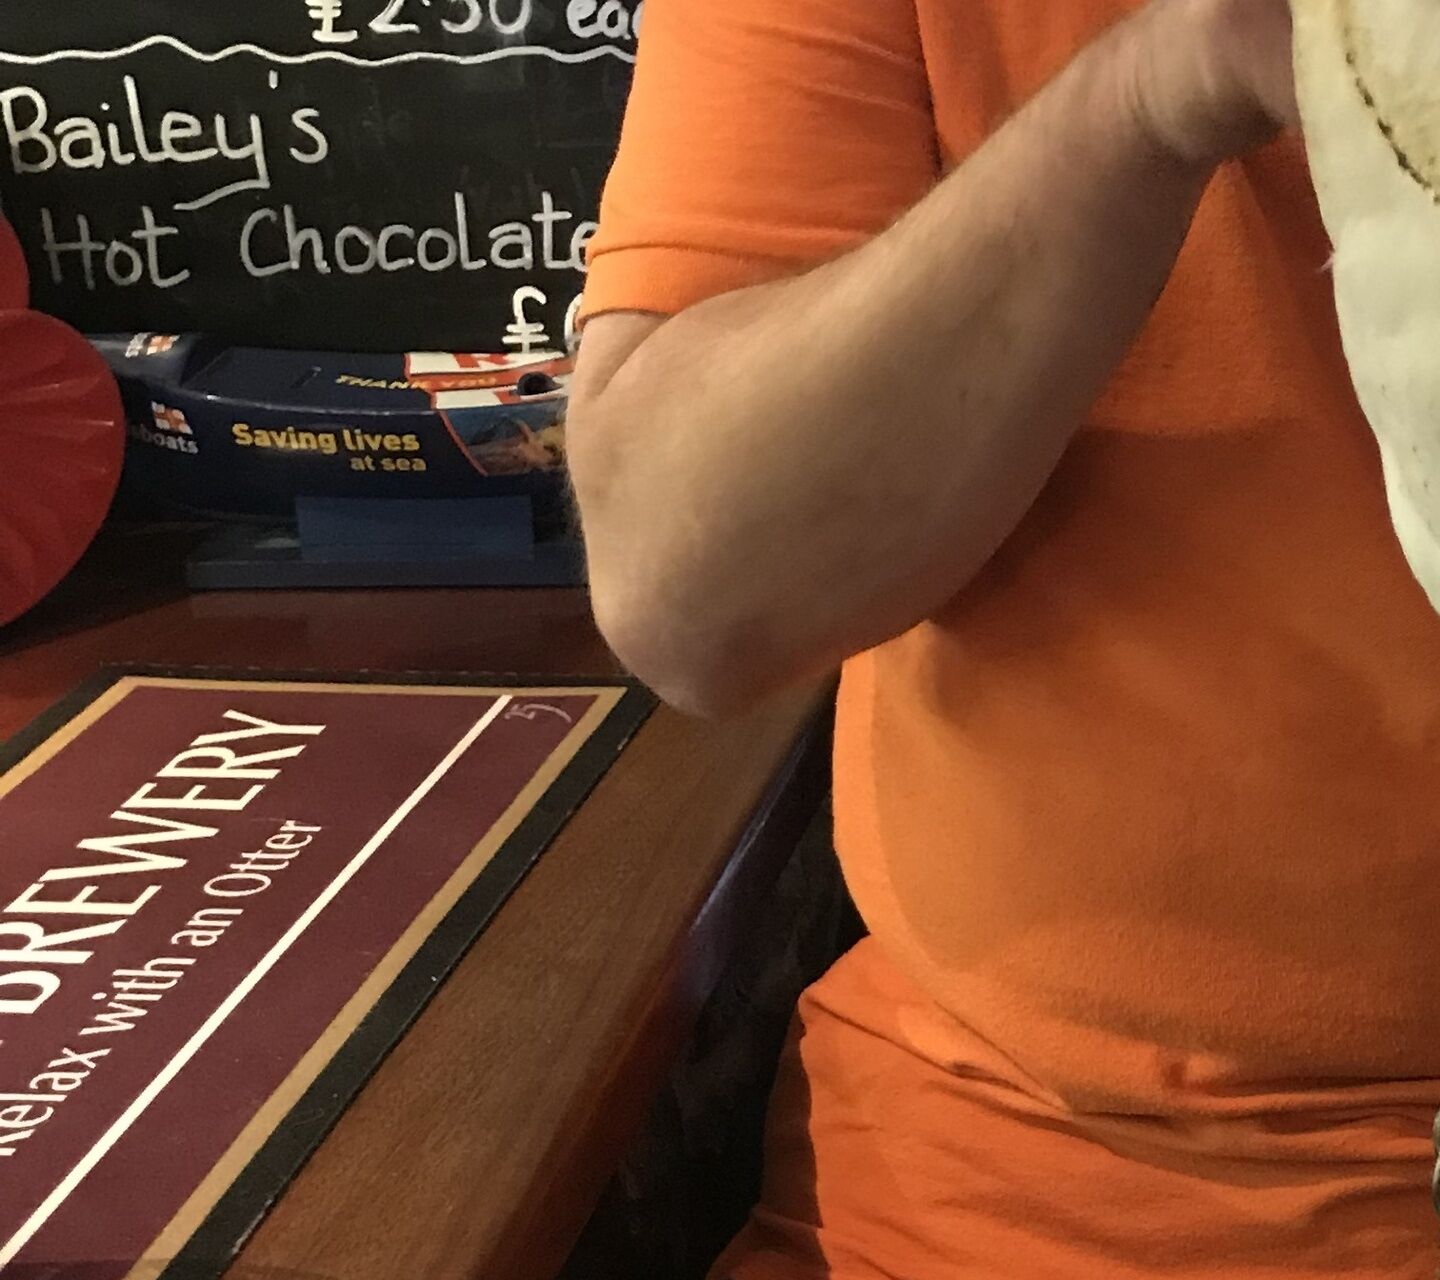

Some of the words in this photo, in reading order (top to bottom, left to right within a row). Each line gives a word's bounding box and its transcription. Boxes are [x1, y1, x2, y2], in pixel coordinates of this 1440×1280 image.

[0, 69, 330, 211] Bailey's
[42, 206, 190, 288] Hot
[240, 191, 601, 274] Chocolate
[231, 423, 338, 455] Saving
[343, 428, 420, 452] lives
[350, 454, 376, 472] at
[380, 455, 428, 472] sea
[203, 819, 322, 898] Otter
[170, 908, 244, 947] an
[78, 957, 197, 1037] with
